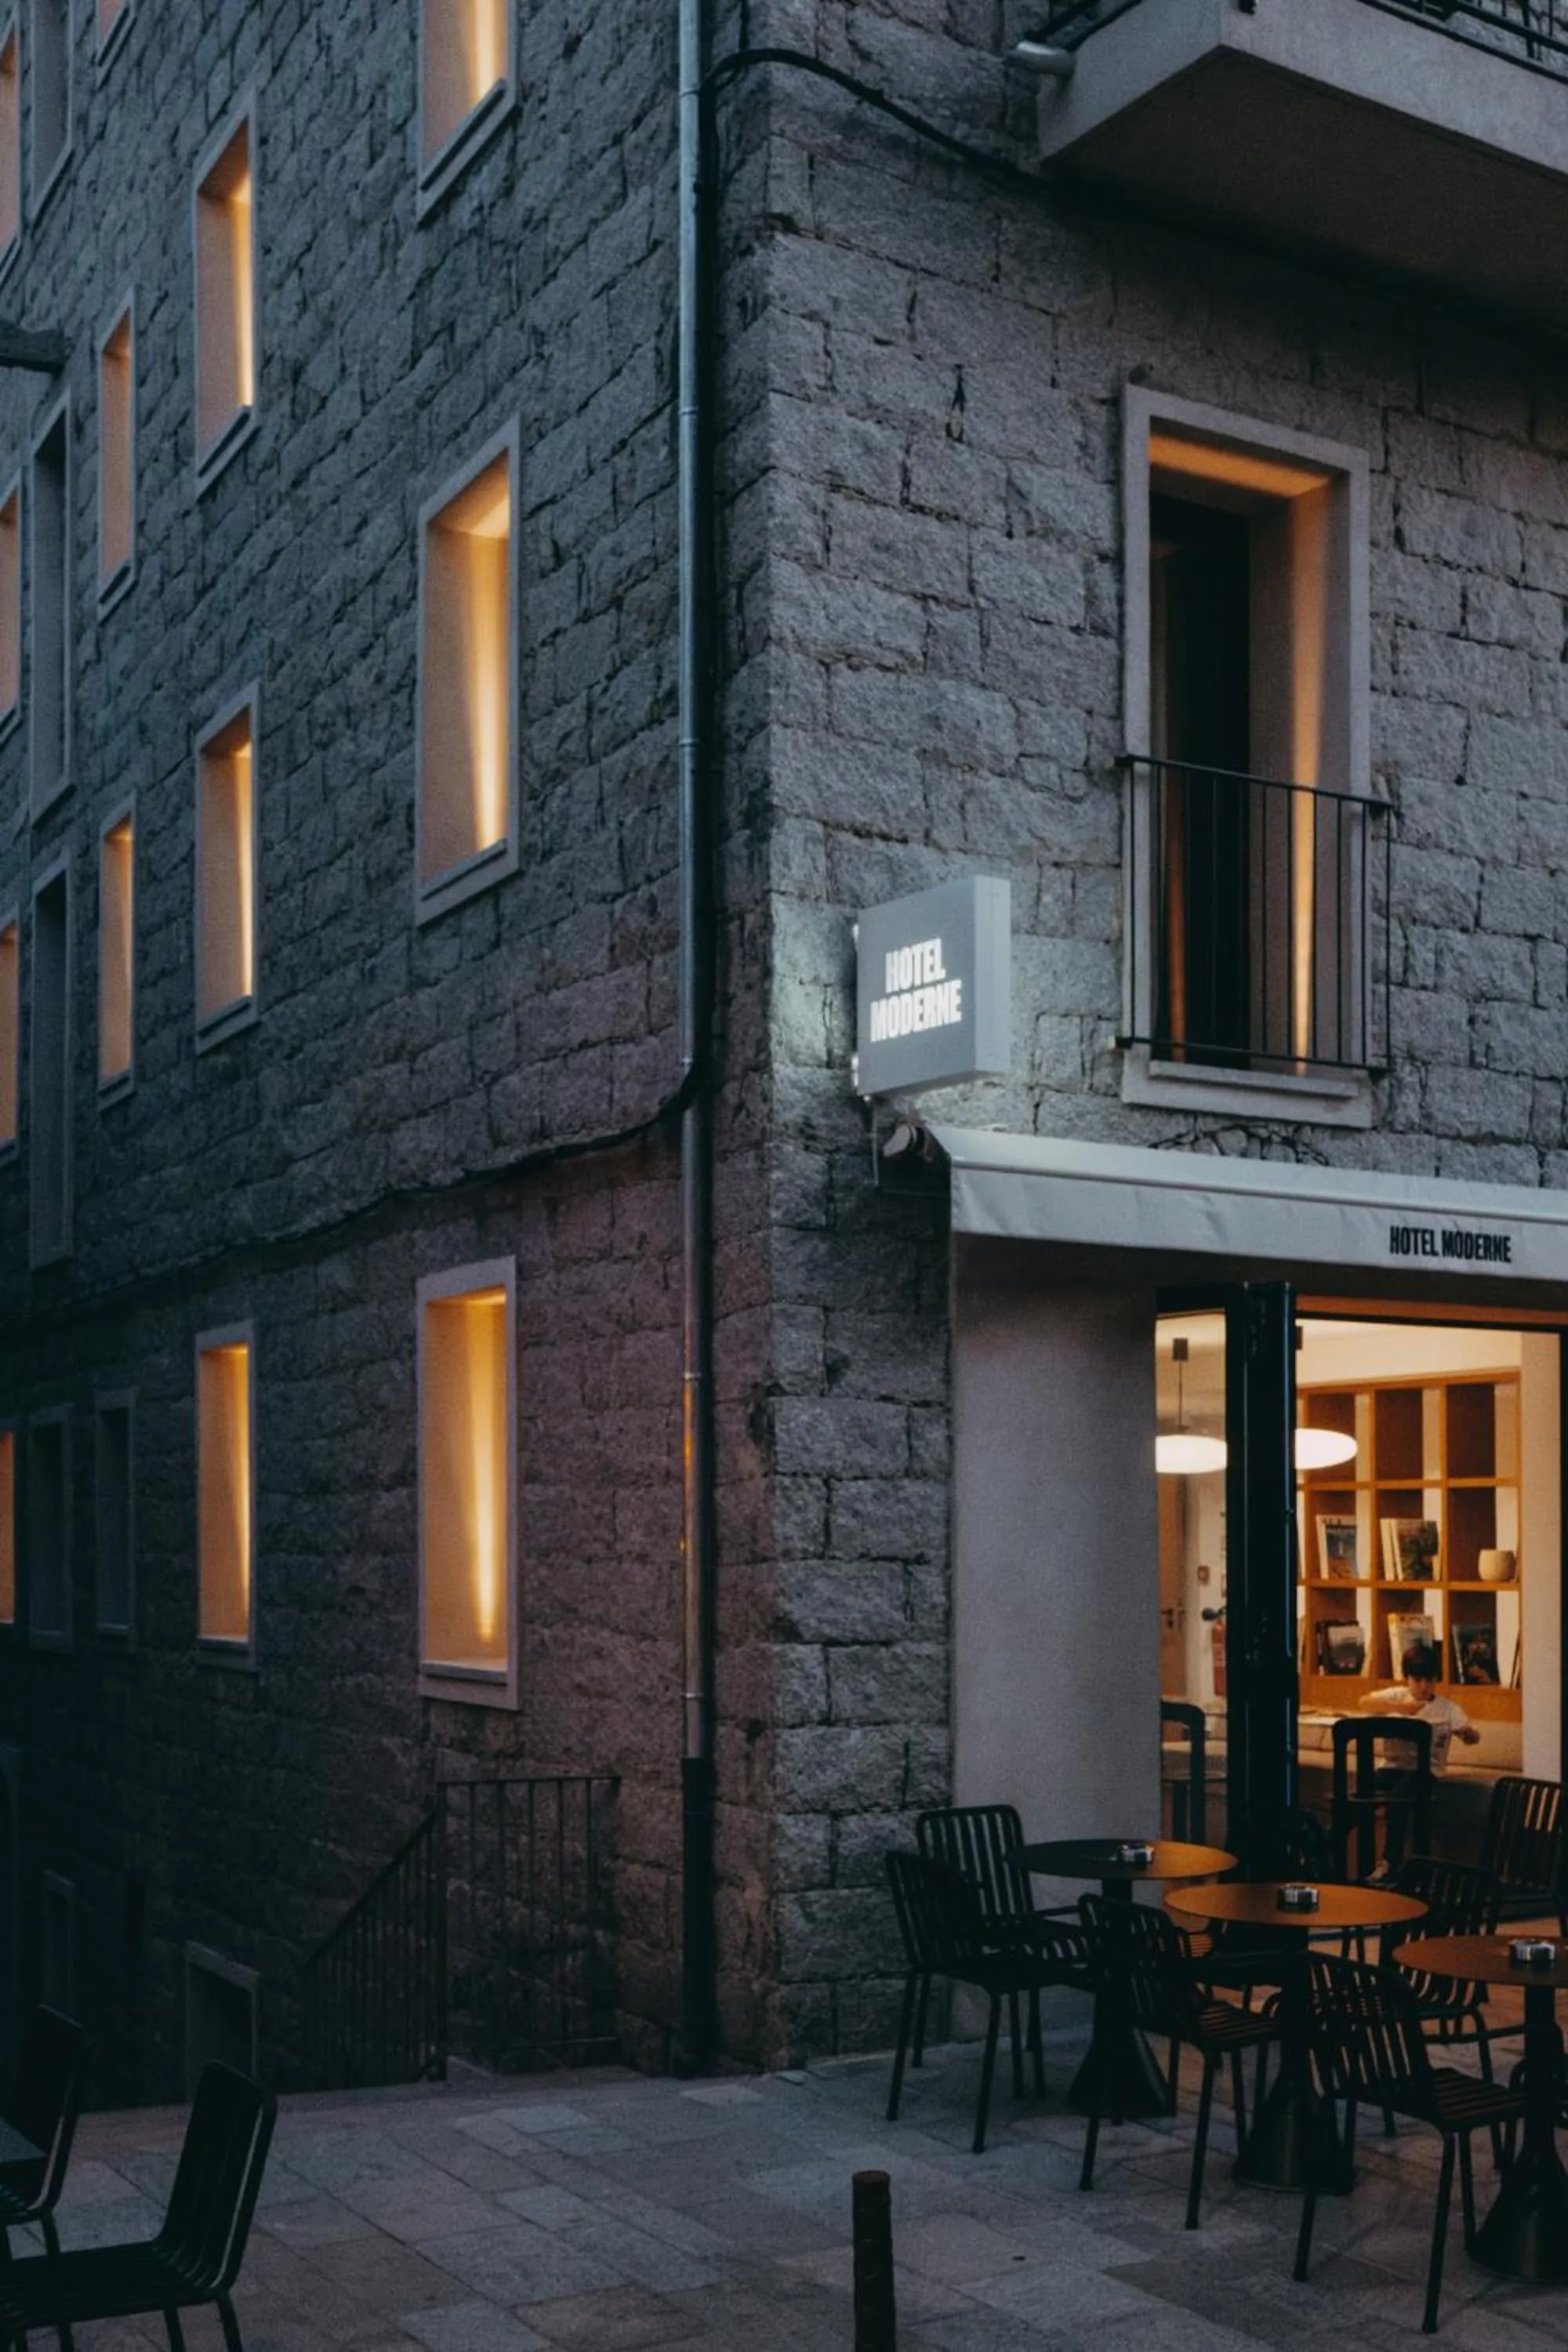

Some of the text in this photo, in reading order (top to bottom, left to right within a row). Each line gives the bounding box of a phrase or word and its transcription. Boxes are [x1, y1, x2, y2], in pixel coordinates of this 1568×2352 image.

[885, 938, 946, 993] HOTEL
[870, 978, 962, 1043] MODERNE
[1389, 1225, 1512, 1263] HOTEL MODERNE
